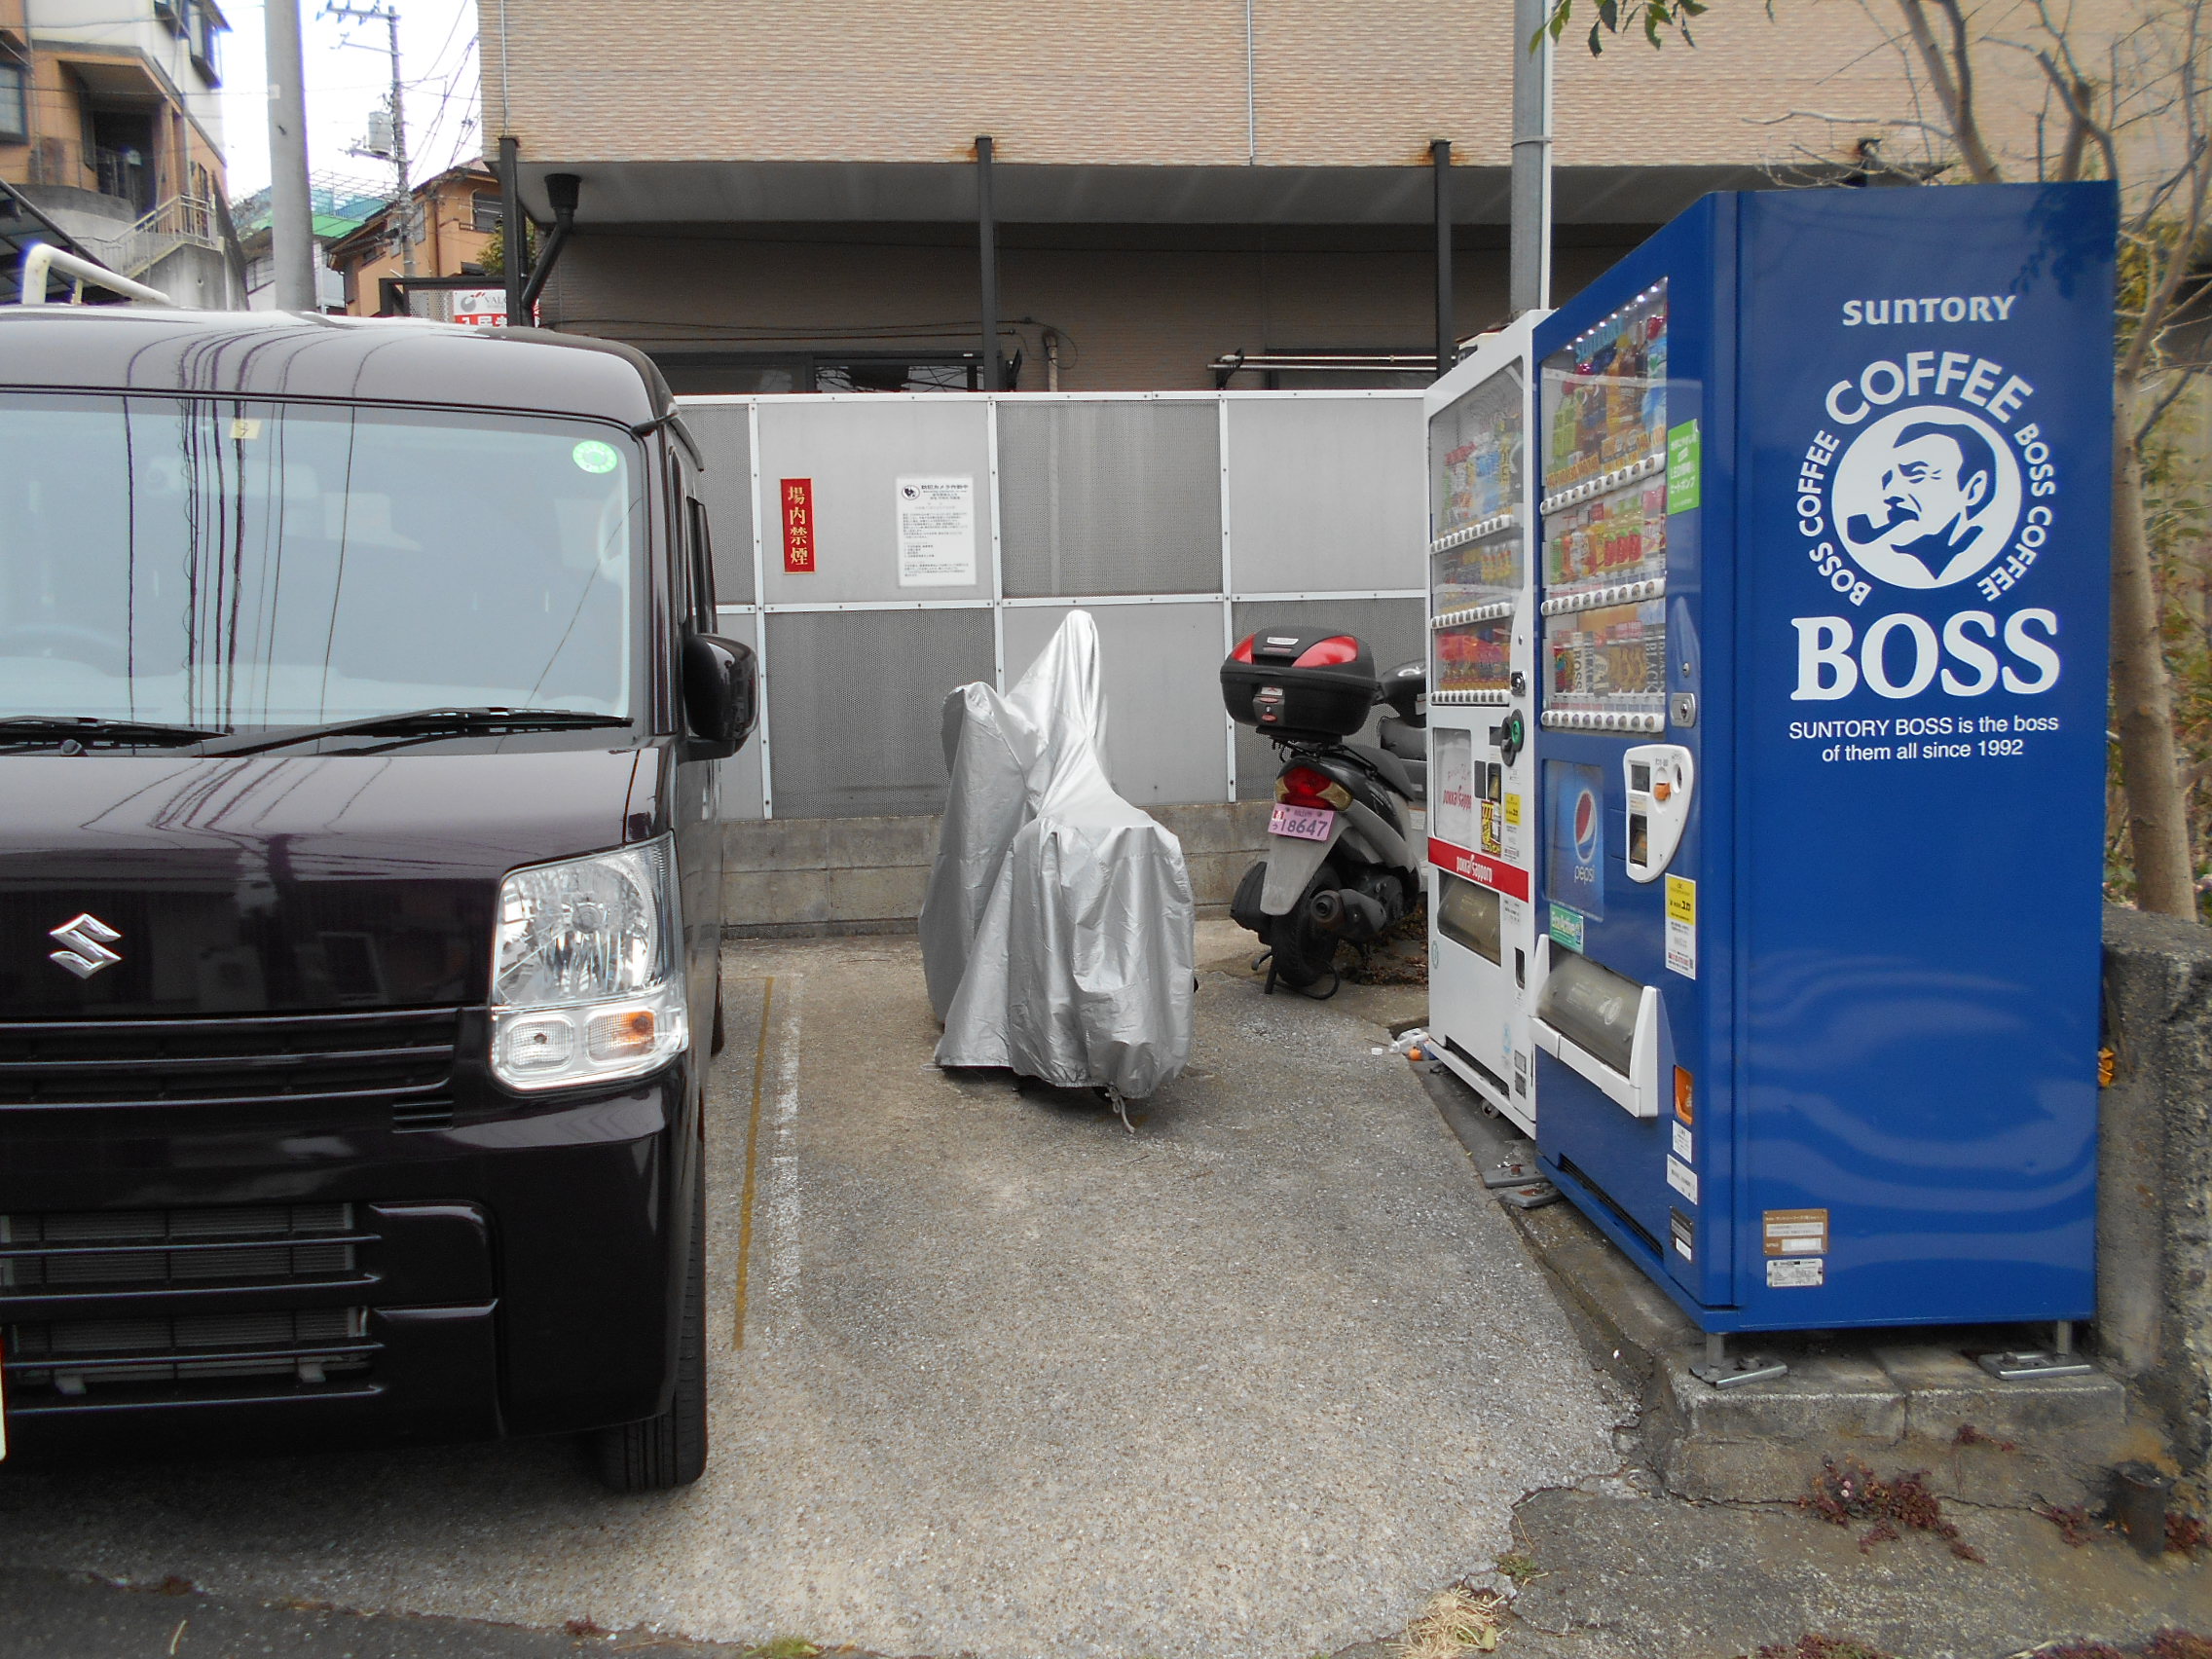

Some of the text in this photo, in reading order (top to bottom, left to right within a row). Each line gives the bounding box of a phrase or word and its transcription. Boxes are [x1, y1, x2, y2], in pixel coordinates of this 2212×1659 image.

[1842, 295, 2017, 327] SUNTORY
[1825, 350, 2034, 424] COFFEE
[788, 486, 808, 566] 場内禁煙
[1796, 429, 1872, 608] BOSS COFFEE
[1976, 423, 2056, 602] BOSS COFFEE
[1789, 608, 2061, 701] BOSS
[1789, 715, 2059, 741] SUNTORY BOSS is the boss
[1822, 739, 2024, 762] of them all since 1992
[1573, 865, 1596, 885] pepsi
